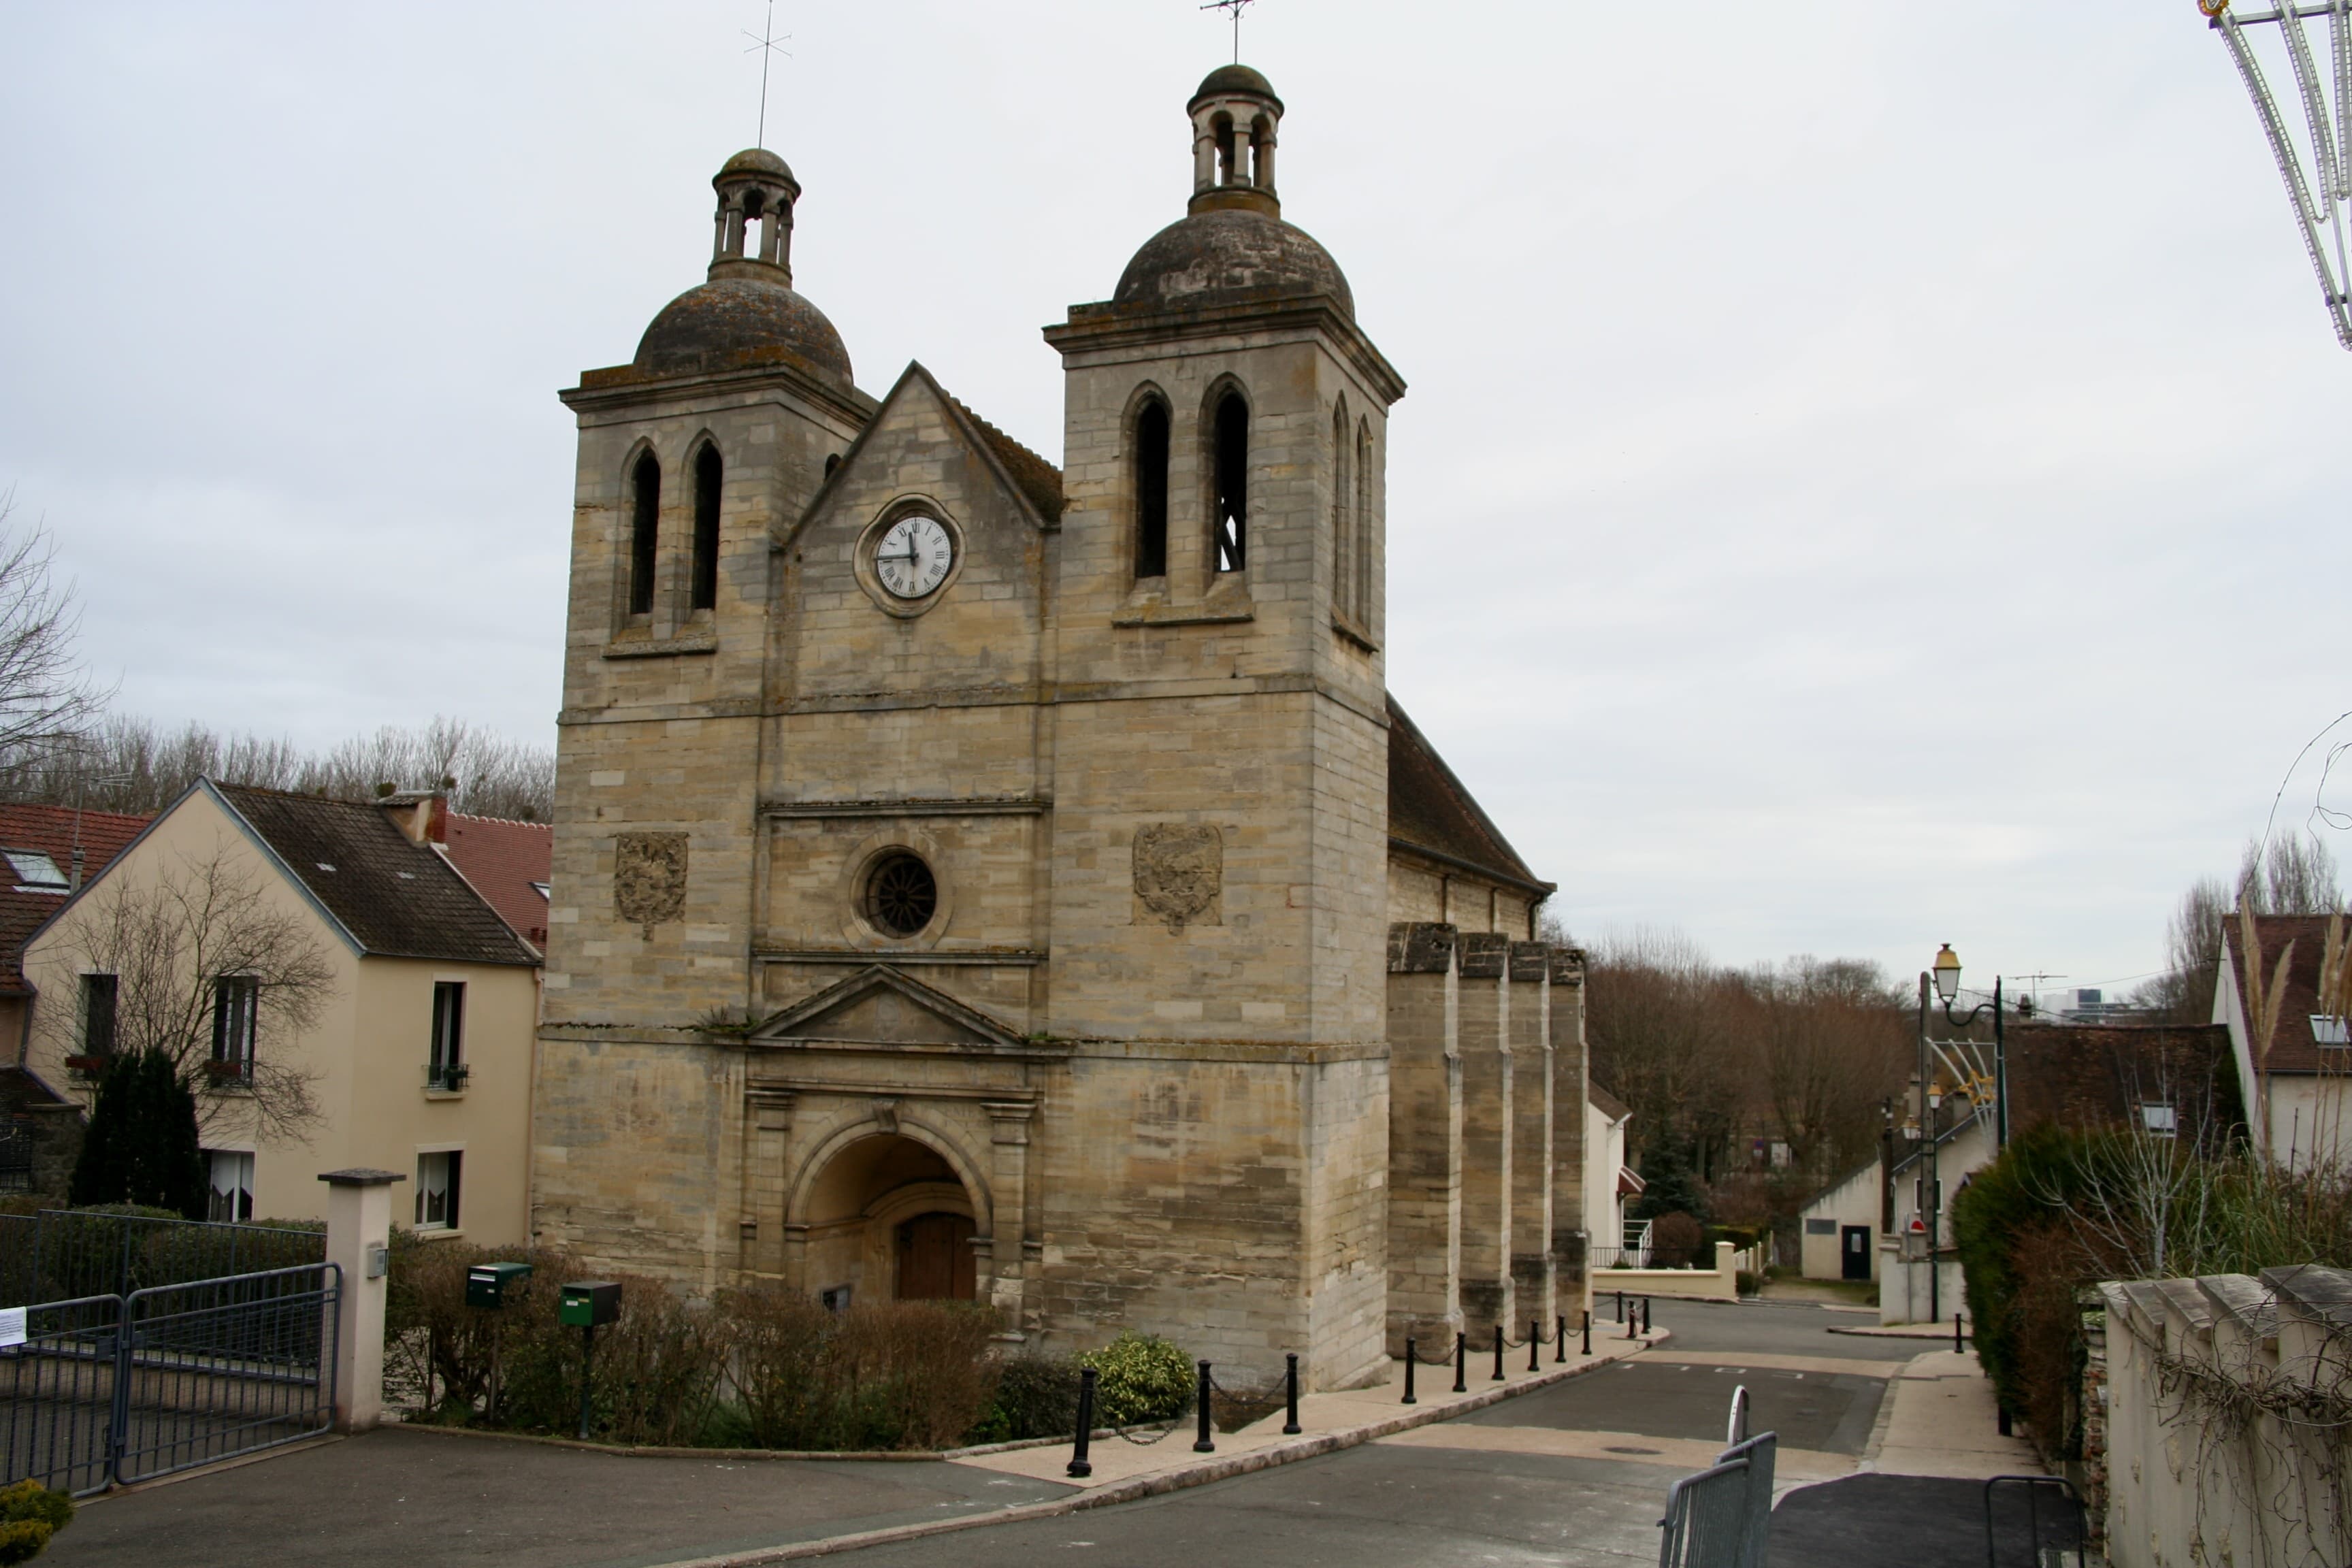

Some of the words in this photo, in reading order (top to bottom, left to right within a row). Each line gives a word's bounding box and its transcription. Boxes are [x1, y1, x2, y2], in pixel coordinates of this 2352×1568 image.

[911, 523, 920, 534] XII
[925, 525, 932, 536] I
[887, 540, 897, 549] X
[932, 536, 943, 545] II
[930, 564, 943, 576] IIII
[909, 581, 915, 591] VI
[923, 577, 930, 587] V
